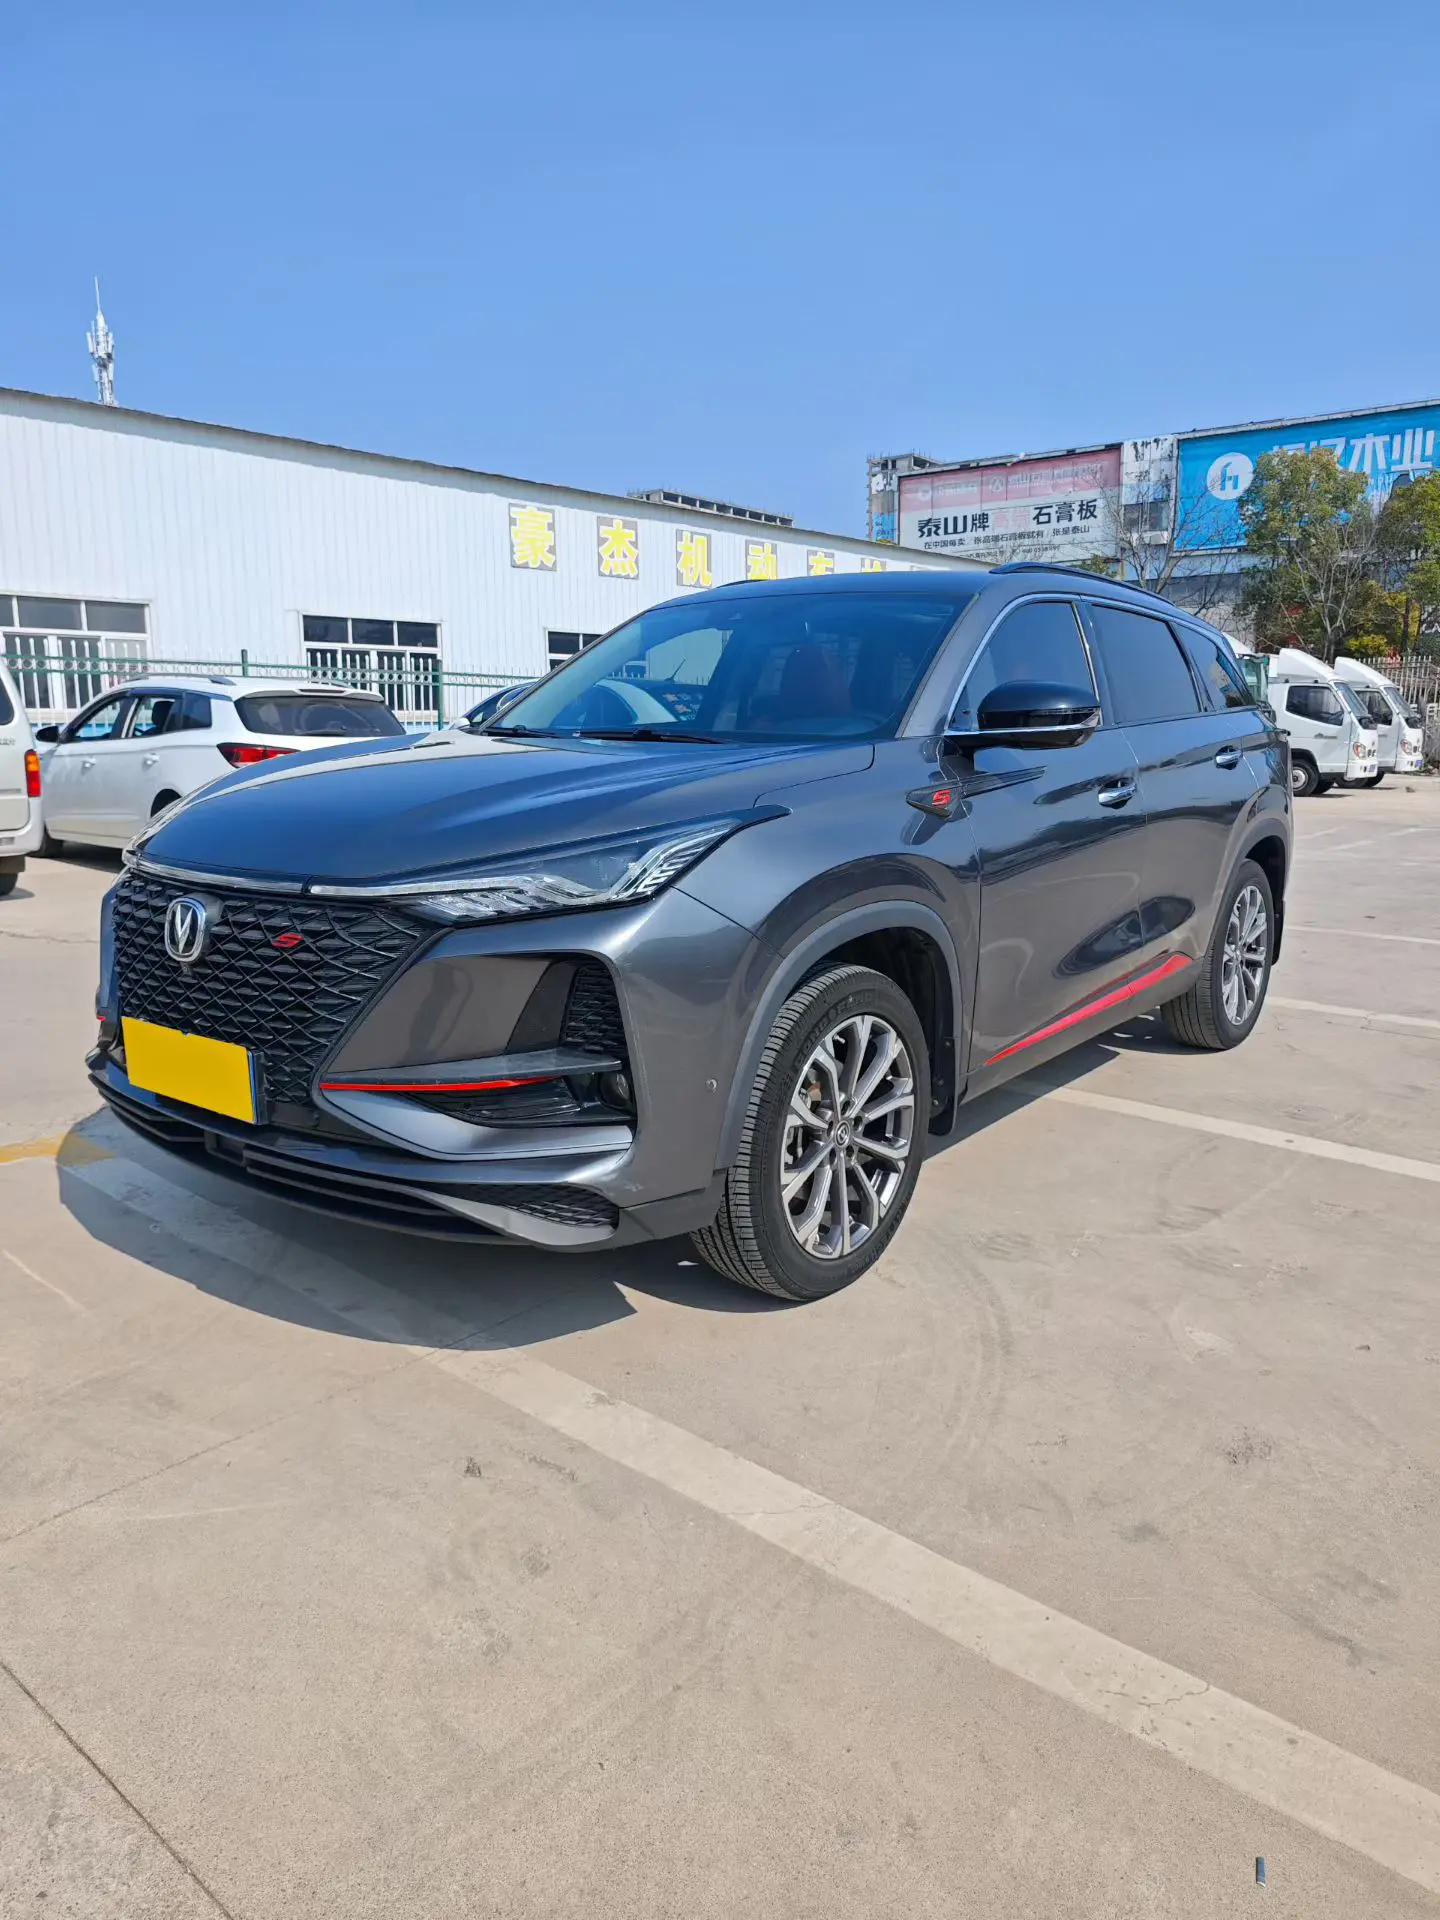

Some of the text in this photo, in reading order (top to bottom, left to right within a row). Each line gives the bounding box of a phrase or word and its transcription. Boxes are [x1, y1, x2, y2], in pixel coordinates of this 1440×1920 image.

[917, 512, 990, 538] 泰山牌
[1032, 499, 1098, 525] 石膏板
